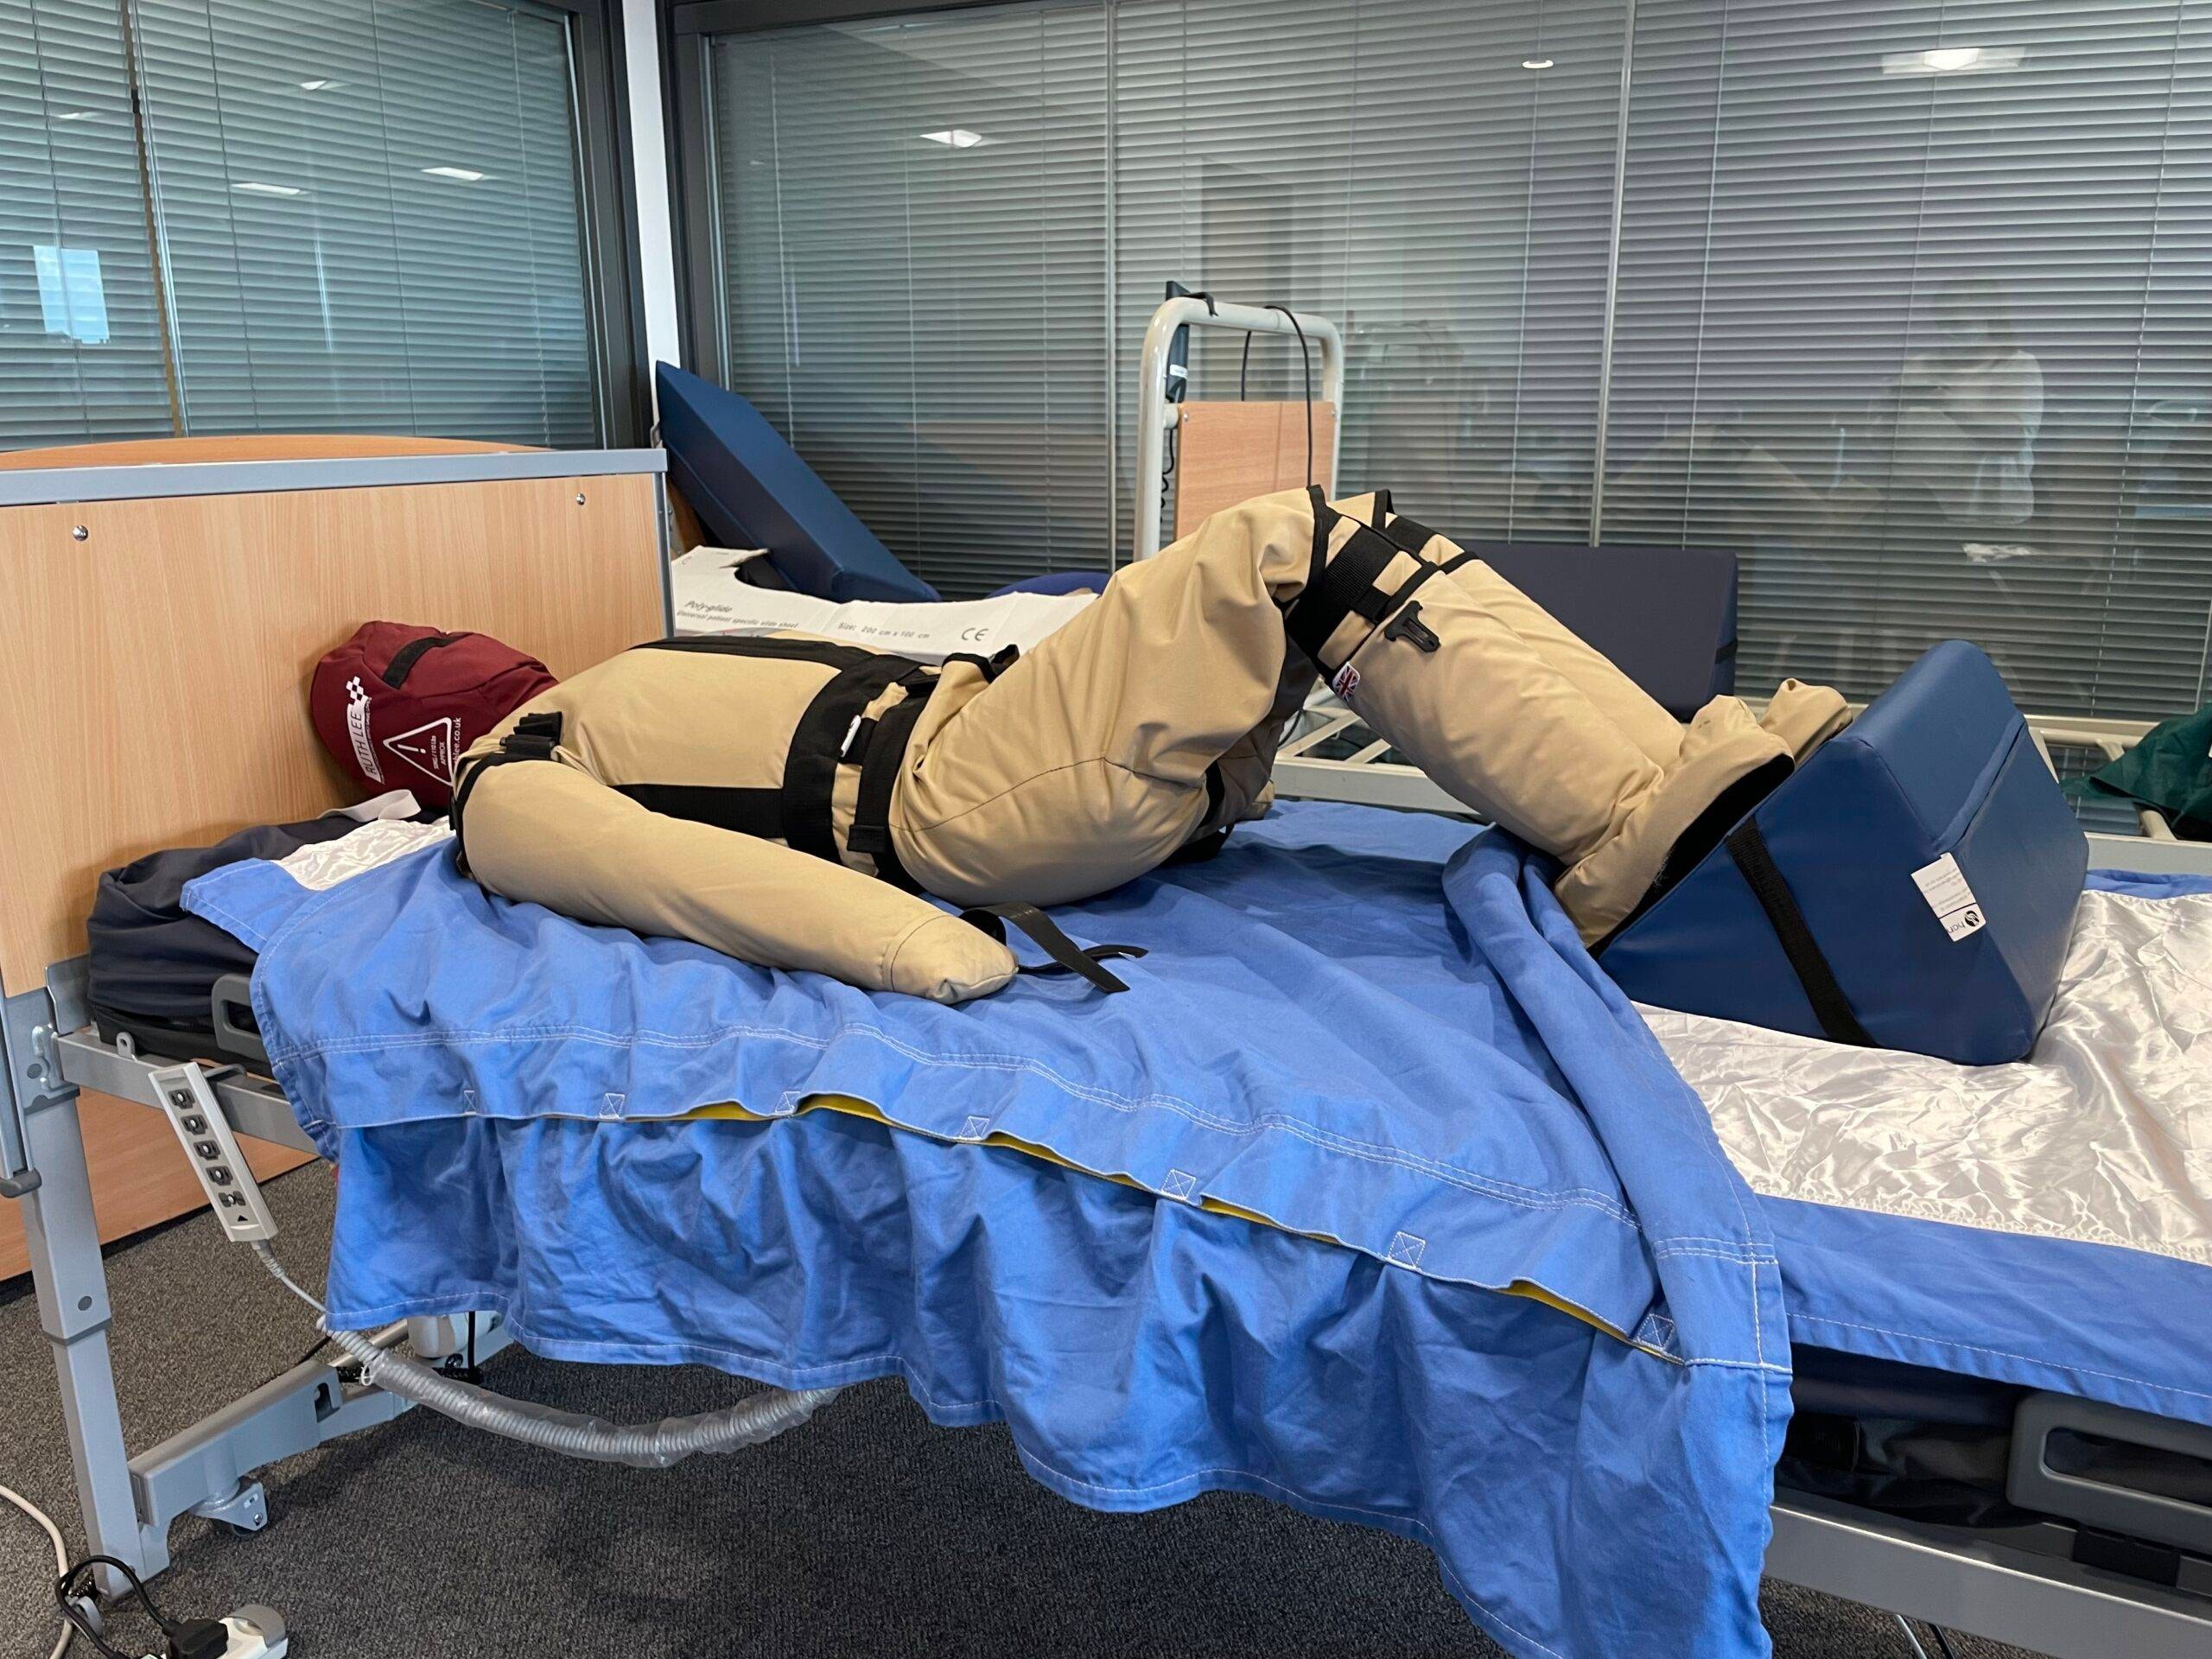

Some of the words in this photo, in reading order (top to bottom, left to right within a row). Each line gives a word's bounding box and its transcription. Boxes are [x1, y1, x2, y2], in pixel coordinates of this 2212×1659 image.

[837, 621, 857, 631] Size:
[861, 626, 877, 634] 200
[961, 627, 989, 642] CE
[350, 710, 363, 738] LEE
[354, 739, 378, 775] RUTH
